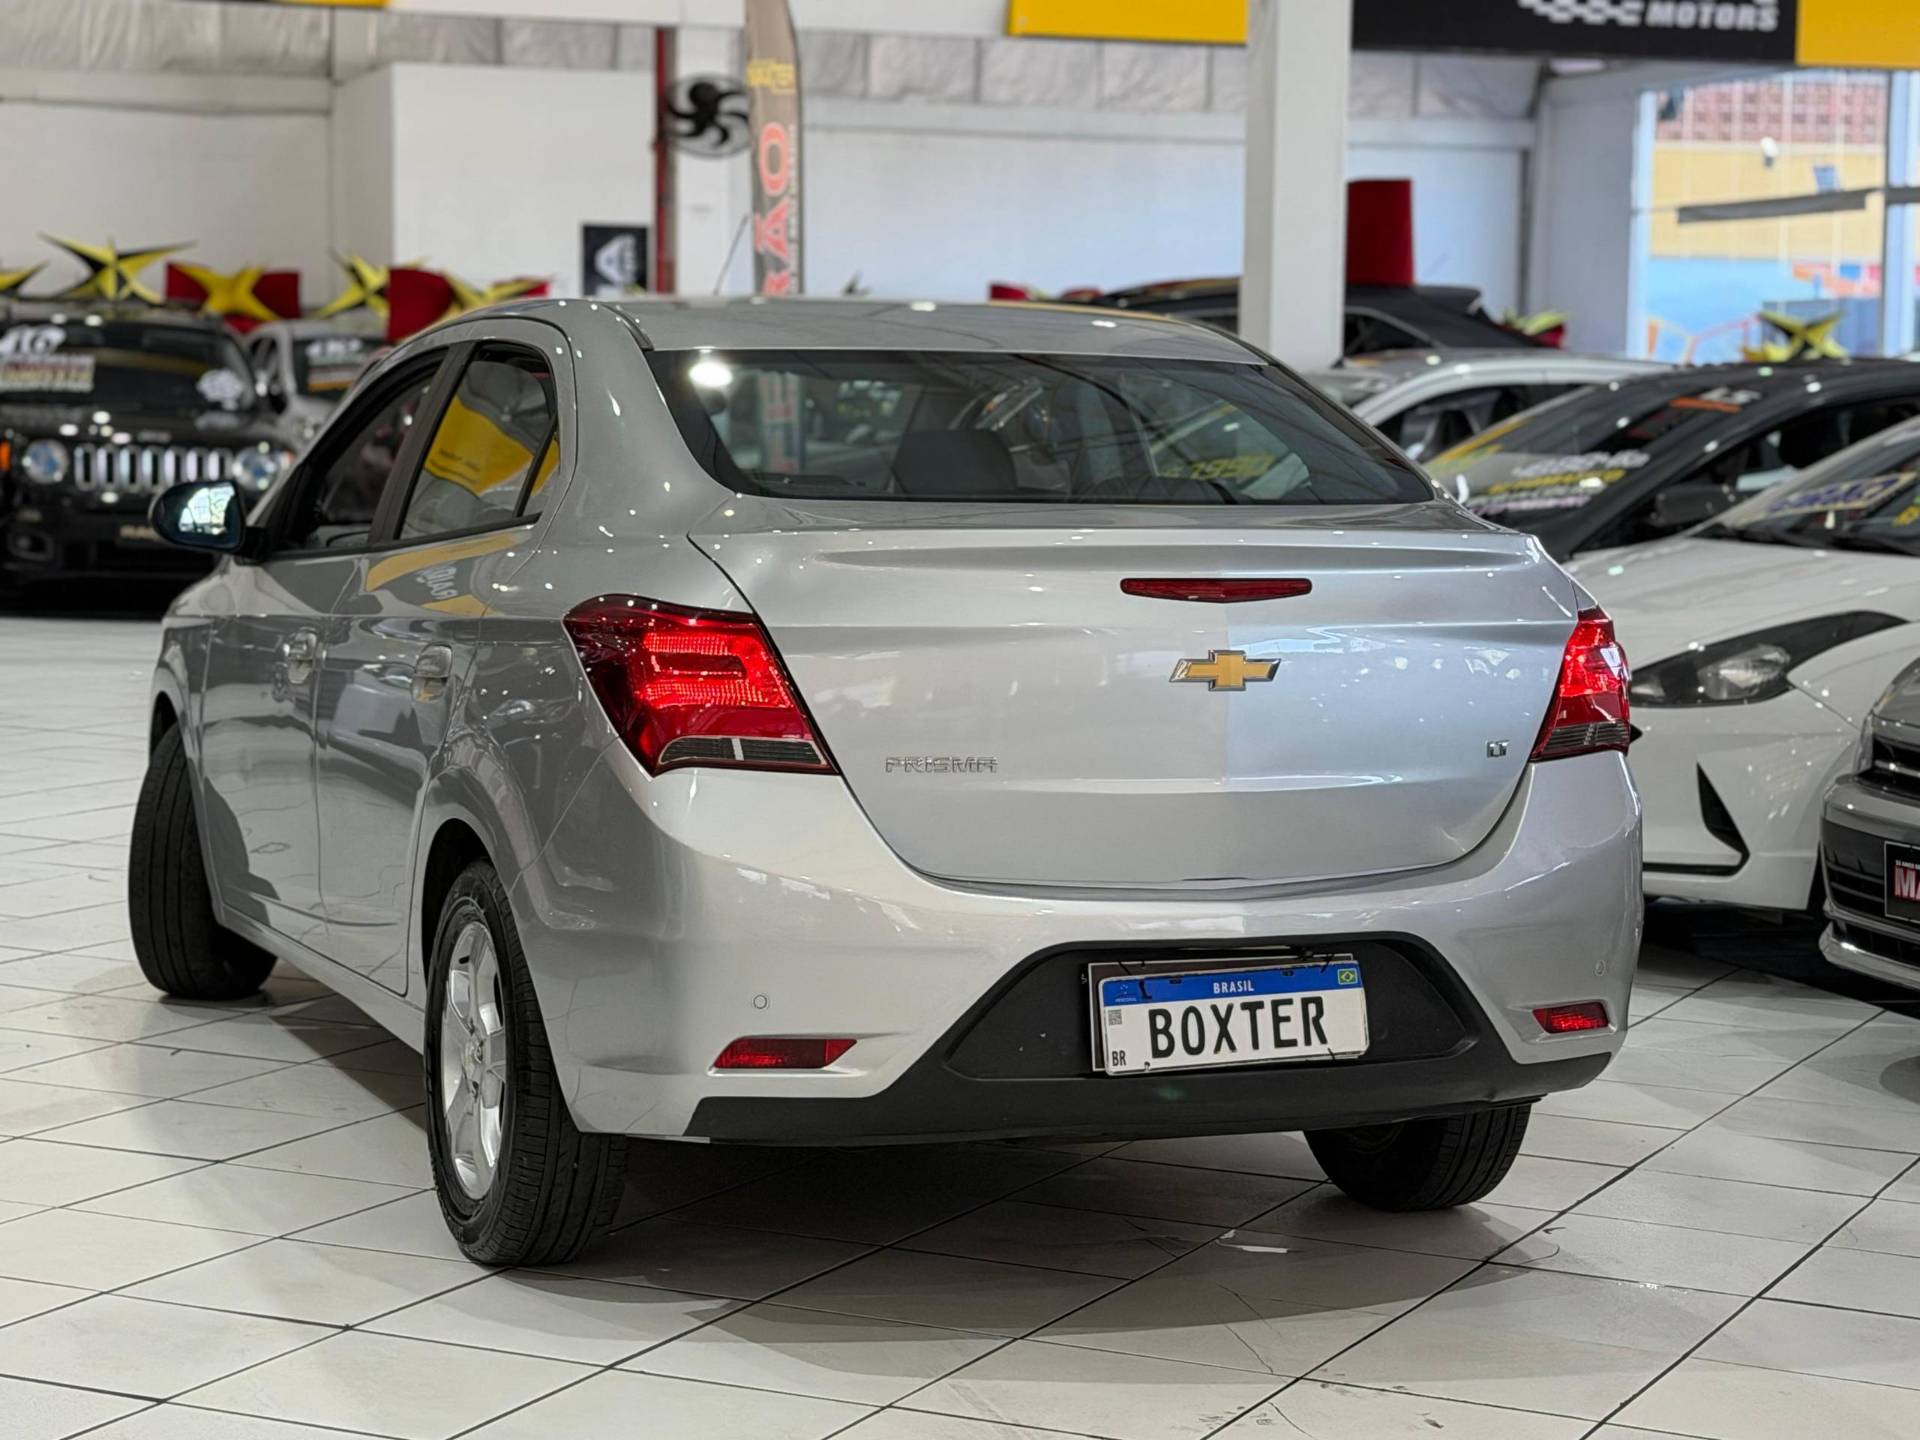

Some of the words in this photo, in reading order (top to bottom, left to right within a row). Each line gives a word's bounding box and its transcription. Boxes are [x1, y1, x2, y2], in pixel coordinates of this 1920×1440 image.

[1487, 740, 1510, 758] LT
[884, 757, 999, 773] PRISMA
[1212, 979, 1255, 994] BRASIL
[1148, 996, 1328, 1059] BOXTER
[1111, 1051, 1126, 1067] BR
